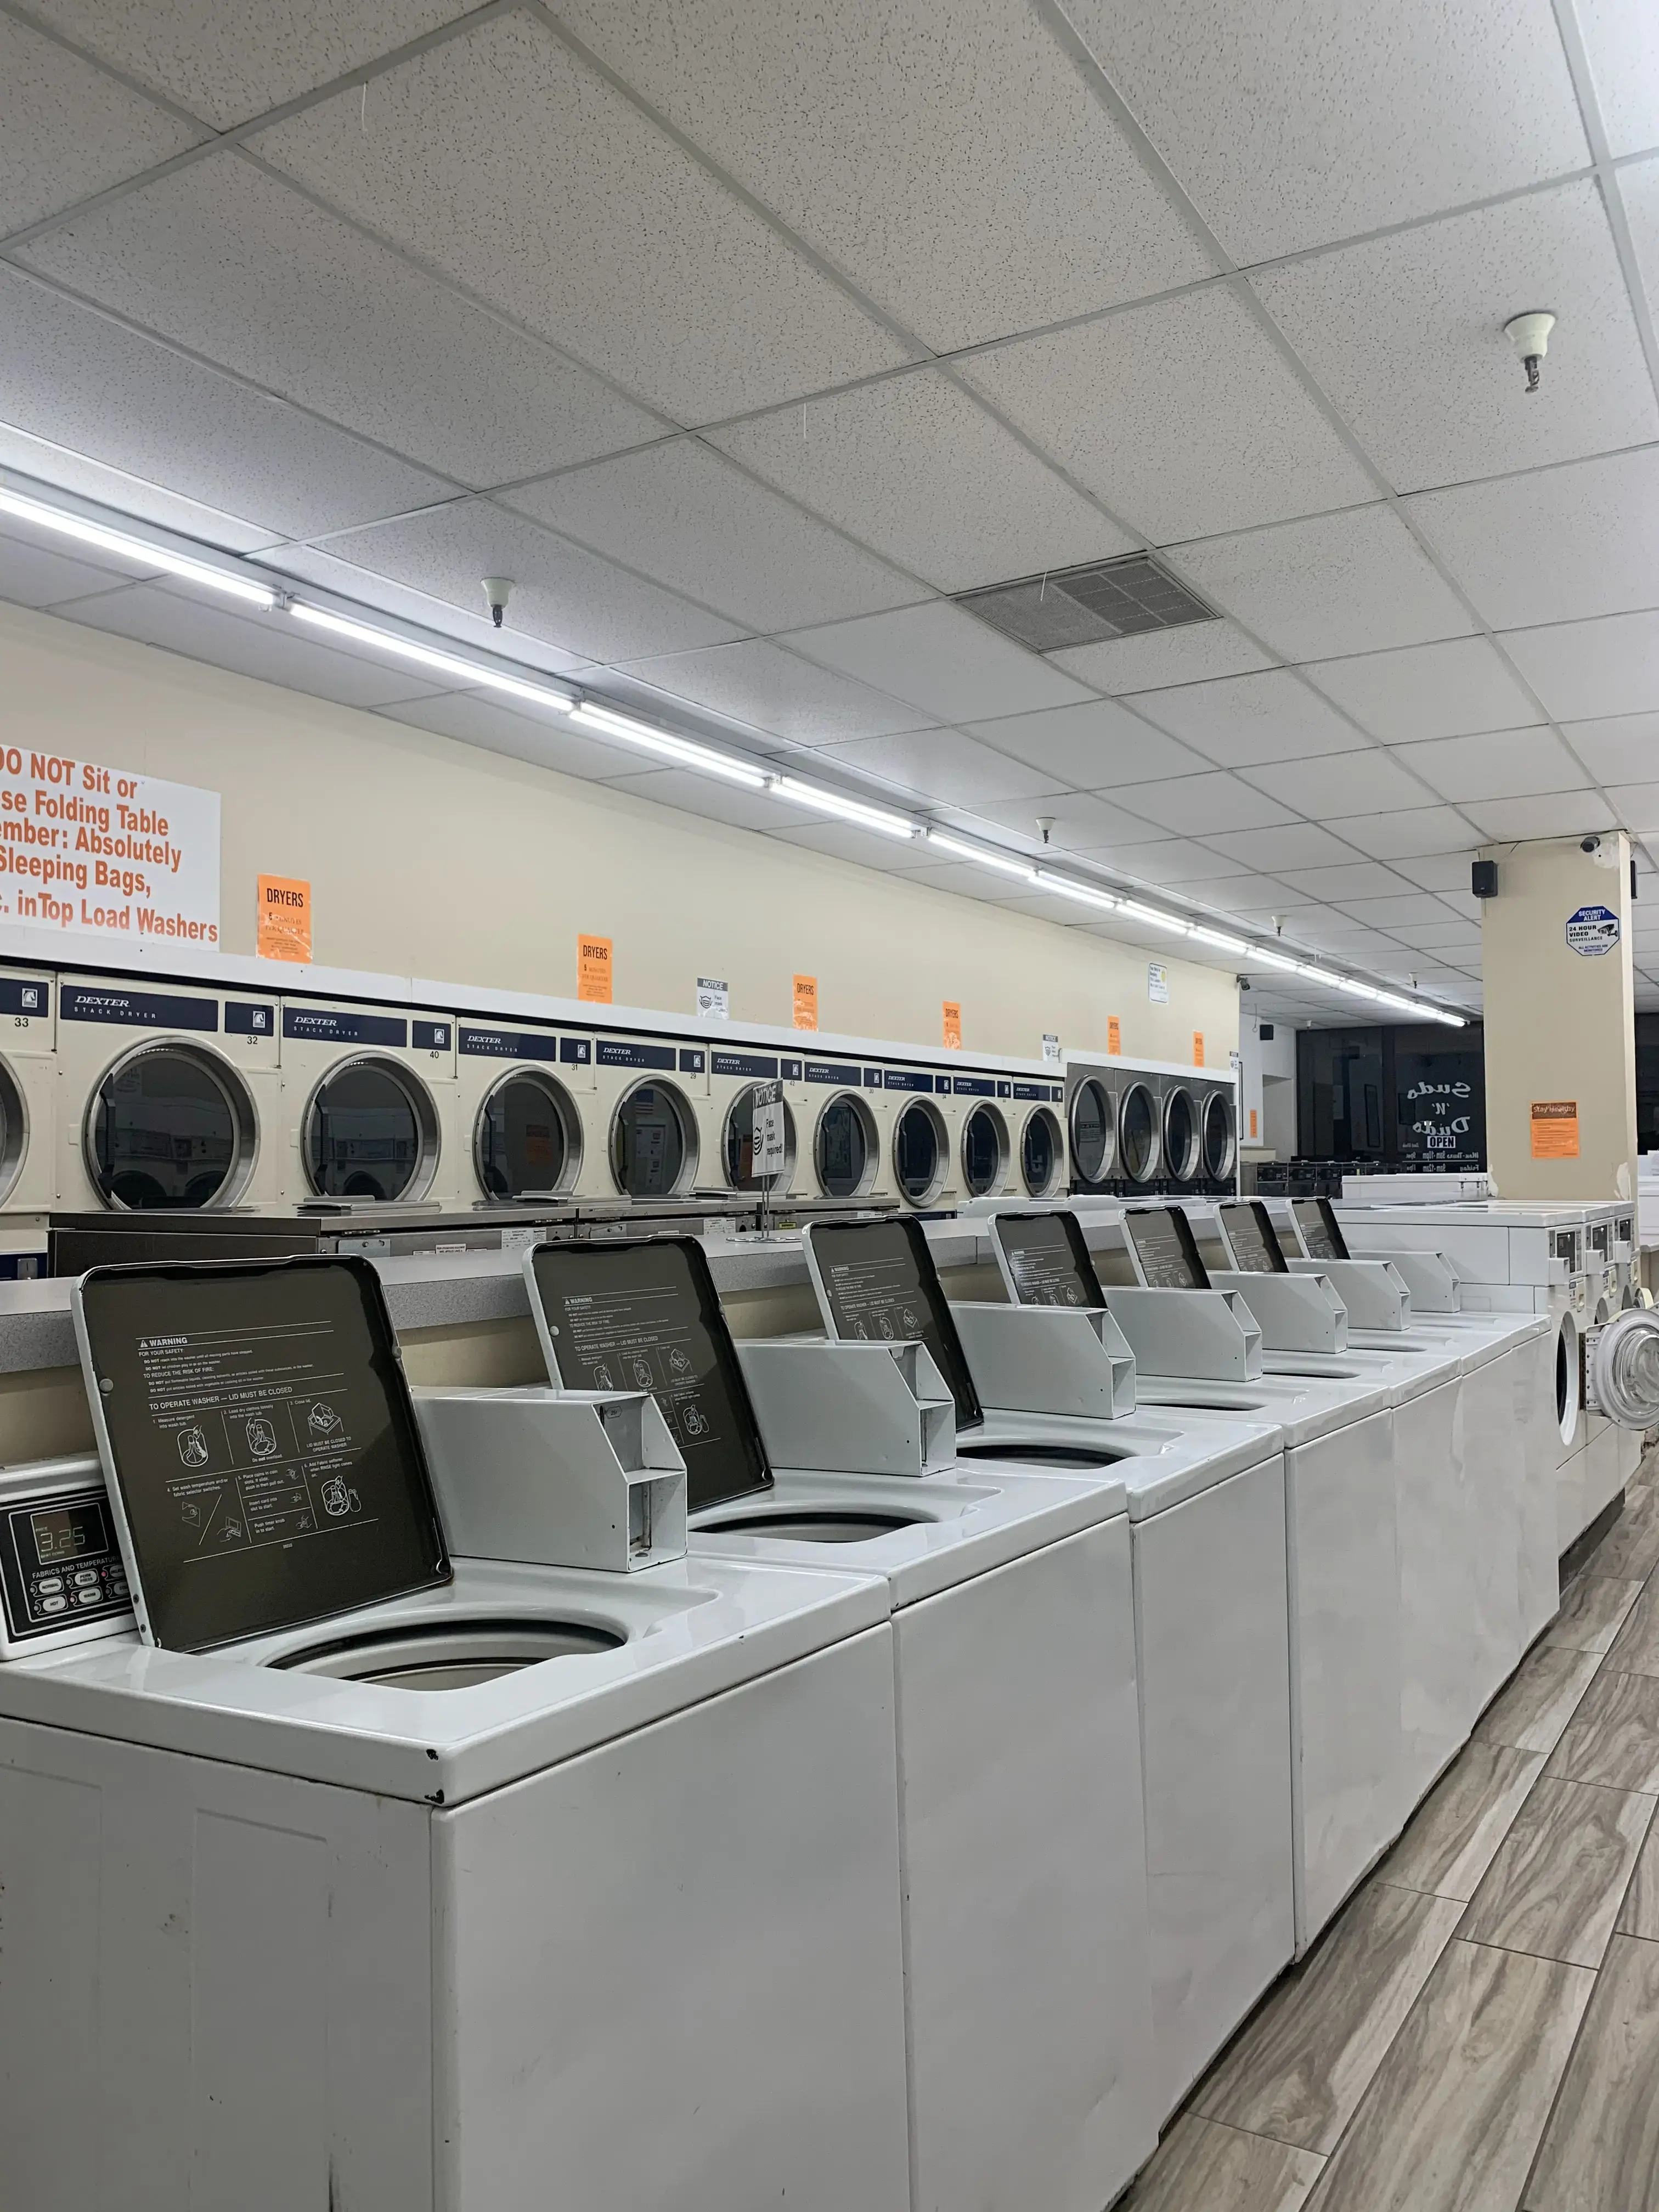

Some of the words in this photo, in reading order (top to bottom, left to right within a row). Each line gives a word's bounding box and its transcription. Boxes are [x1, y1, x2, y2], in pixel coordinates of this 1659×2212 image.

[0, 746, 22, 775] O
[31, 753, 75, 786] NOT
[82, 765, 110, 794] Sit
[117, 779, 138, 799] or
[35, 789, 109, 833] Folding
[116, 803, 168, 836] Table
[0, 817, 67, 849] mber:
[75, 826, 182, 872] Absolutely
[95, 860, 150, 899] Bags,
[267, 888, 303, 907] DRYERS
[81, 899, 129, 930] Load
[137, 907, 218, 942] Washers
[583, 945, 607, 960] DRYERS
[703, 979, 723, 990] NOTICE
[797, 983, 814, 995] DRYERS
[75, 996, 129, 1007] DEXTER
[75, 1007, 110, 1015] STACK
[945, 1008, 958, 1019] DRYERS
[14, 1018, 29, 1027] 33
[294, 1017, 337, 1026] DEXTER
[247, 1036, 258, 1045] 32
[467, 1035, 501, 1043] DEXTER
[754, 1085, 777, 1108] NOTICE
[766, 1119, 774, 1128] Face
[767, 1131, 775, 1142] mask
[1430, 1137, 1454, 1147] OPEN
[767, 1143, 783, 1157] required!
[149, 1337, 188, 1347] WARNING
[160, 1400, 191, 1409] OPERATE
[191, 1396, 219, 1405] WASHER
[240, 1391, 257, 1399] MUST
[268, 1386, 292, 1395] CLOSED
[41, 1526, 85, 1552] 3.25
[32, 1568, 60, 1579] FABRICS
